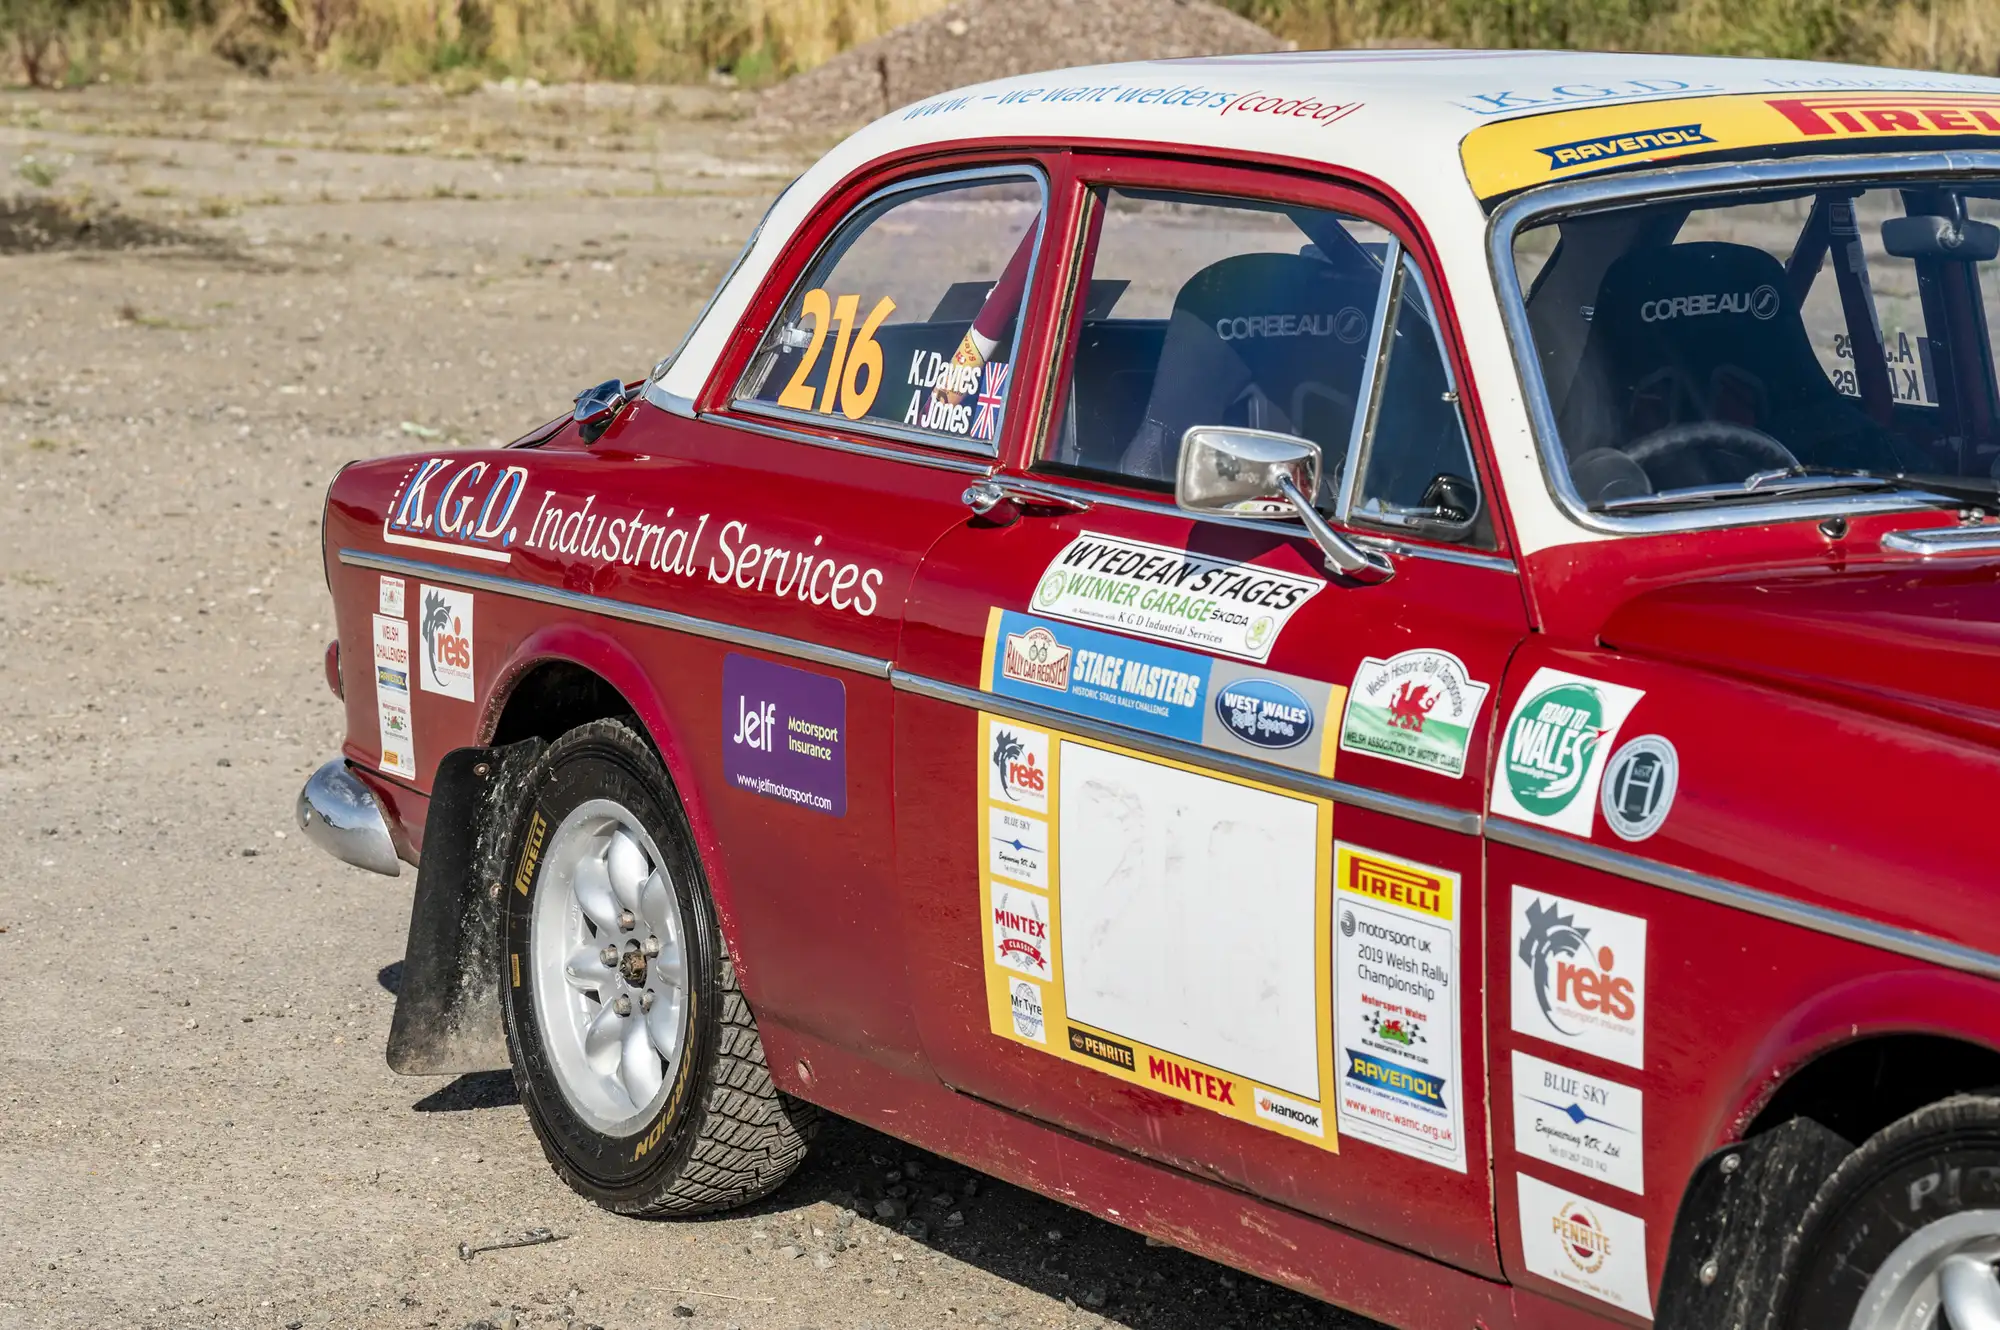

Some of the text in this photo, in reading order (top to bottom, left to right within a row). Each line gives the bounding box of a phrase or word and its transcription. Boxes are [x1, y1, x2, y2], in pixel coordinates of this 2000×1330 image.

[903, 95, 970, 120] www.
[1041, 84, 1122, 103] want
[1554, 128, 1697, 164] RAVENOL
[1641, 293, 1750, 322] CORBEAU
[1216, 314, 1334, 341] CORBEAU
[777, 288, 896, 420] 216
[904, 389, 972, 434] A Jones
[394, 458, 883, 616] K.G.D. Industrial Services
[1062, 541, 1309, 610] WYEDEAN STAGES
[1066, 573, 1141, 605] WINNER
[1140, 588, 1217, 623] GARAGE
[382, 625, 399, 642] WELSH
[437, 616, 471, 670] reis
[1118, 611, 1127, 622] K
[1127, 613, 1135, 624] G
[1136, 615, 1145, 626] D
[1145, 616, 1187, 636] Industrial
[1187, 626, 1223, 644] Services
[376, 643, 408, 664] CHALLENGER
[1005, 640, 1069, 687] RALLY CAR REGISTER
[1073, 649, 1200, 708] STAGE MASTERS
[1366, 671, 1390, 696] Welsh
[1072, 686, 1170, 717] HISTORIC STAGE RALLY CHALLENGE
[1225, 692, 1306, 724] WEST WALES
[733, 695, 776, 752] Jelf
[788, 715, 839, 743] Motorsport
[788, 735, 832, 761] Insurance
[1511, 717, 1599, 798] WALES
[1009, 752, 1044, 792] reis
[736, 774, 832, 811] www.jelfmotorsport.com
[1004, 815, 1031, 831] BLUE SKY
[515, 810, 547, 897] PIRELLI
[1350, 855, 1441, 912] PIRELLI
[995, 907, 1046, 940] MINTEX
[1358, 920, 1416, 948] motorsport
[1008, 940, 1035, 955] CLASSIC
[1358, 943, 1449, 987] 2019 Welsh Rally
[1357, 963, 1435, 1001] Championship
[1556, 946, 1636, 1021] reis
[1010, 994, 1042, 1015] Mr Tyre
[1361, 992, 1427, 1022] Motorsport Wales
[1085, 1037, 1133, 1067] PENRITE
[634, 990, 697, 1162] SCORPION
[1148, 1055, 1235, 1106] MINTEX
[1353, 1057, 1438, 1099] RAVENOL
[1543, 1071, 1610, 1106] BLUE SKY
[1345, 1098, 1453, 1142] www.wnrc.wamc.org.uk
[1535, 1117, 1621, 1157] Engineering UK Ltd
[1552, 1216, 1611, 1255] PENRITE
